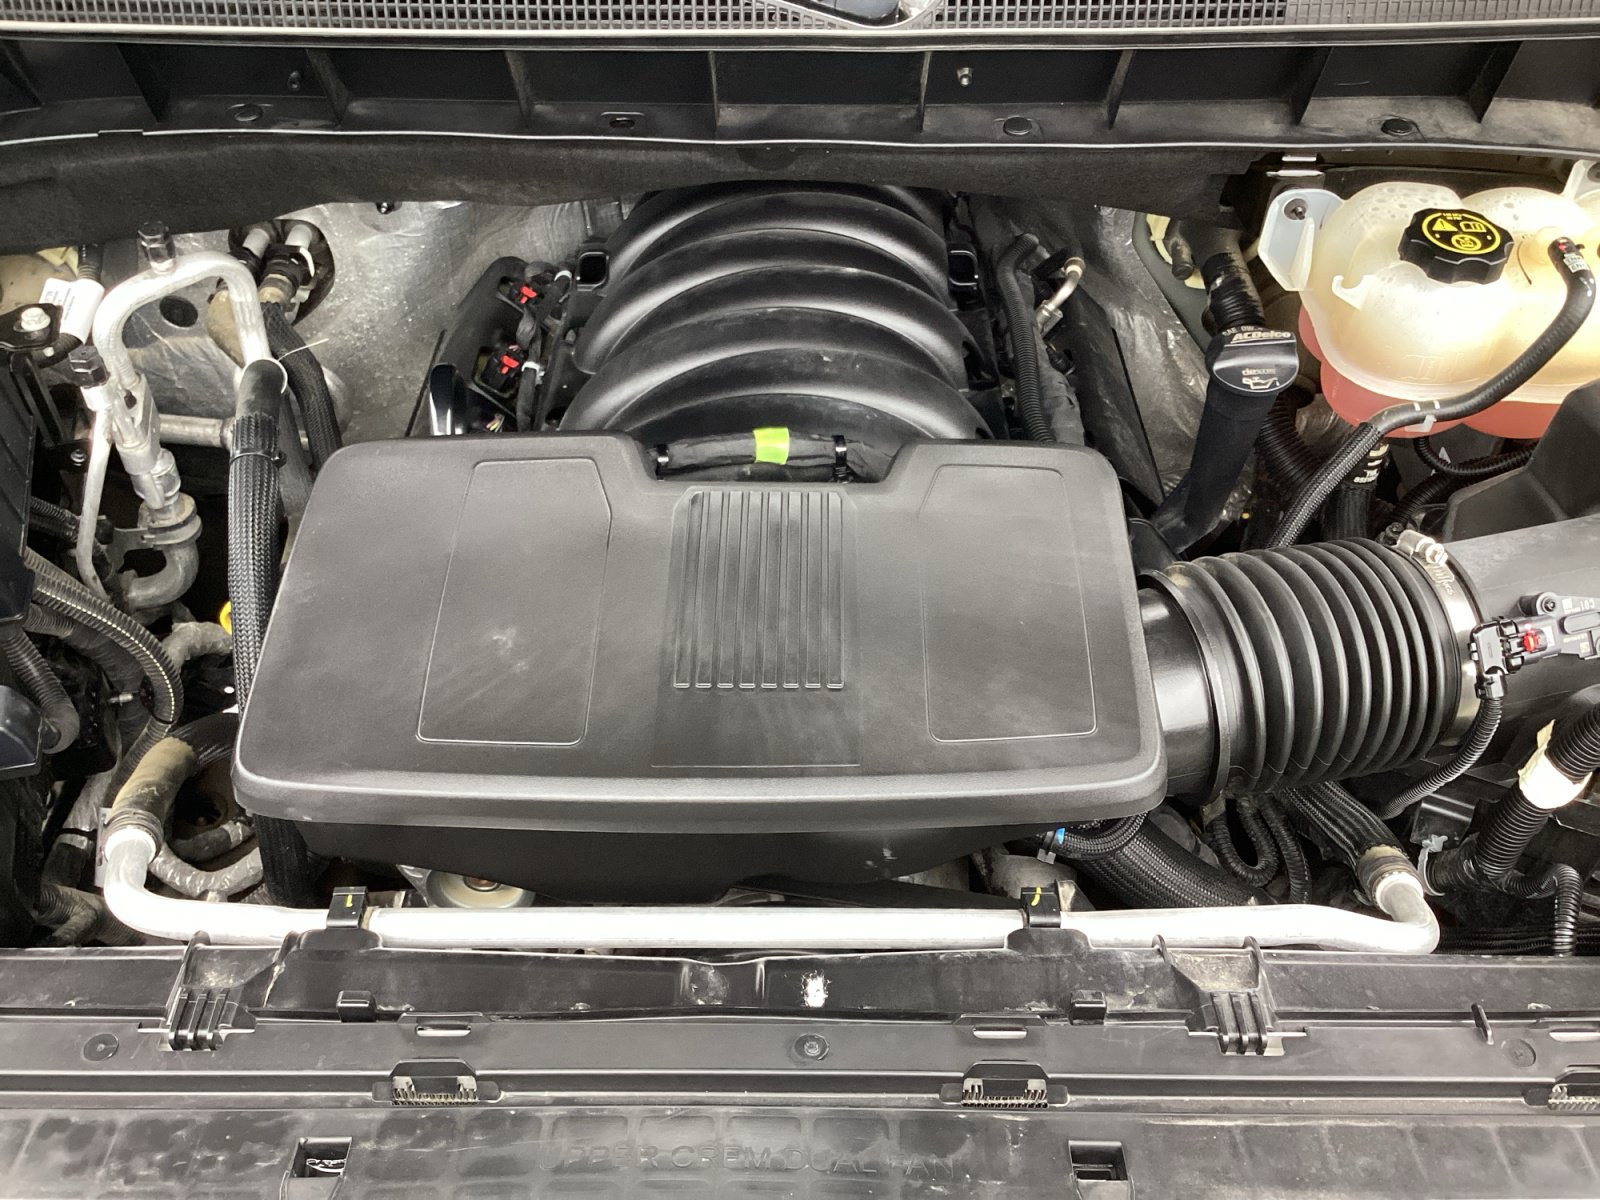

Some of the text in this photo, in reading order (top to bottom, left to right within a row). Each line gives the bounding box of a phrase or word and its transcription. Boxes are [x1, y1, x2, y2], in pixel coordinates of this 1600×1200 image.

[1231, 331, 1291, 341] ACDelco
[540, 1144, 658, 1171] UPPER
[784, 1147, 877, 1175] DUAL
